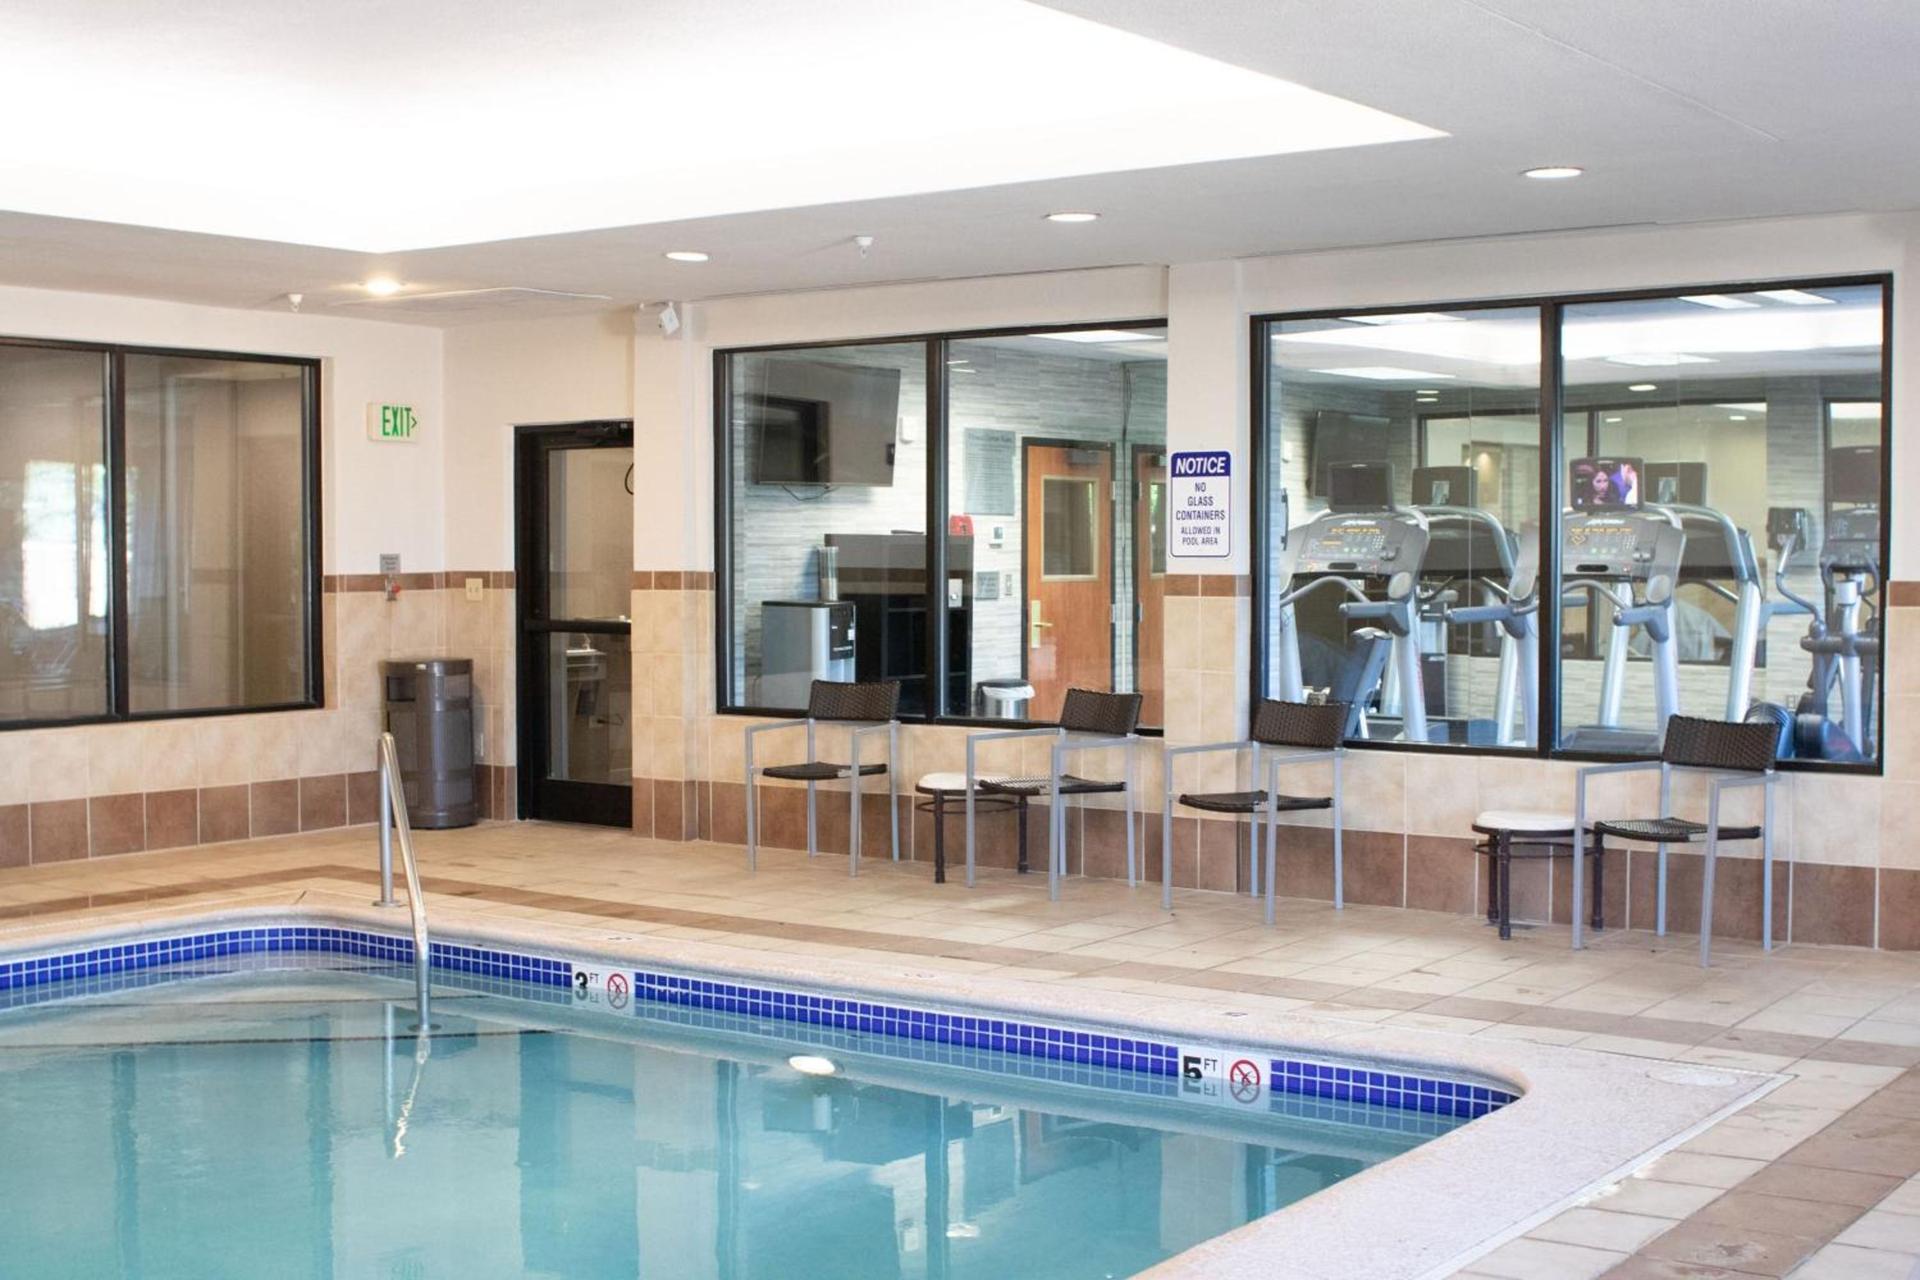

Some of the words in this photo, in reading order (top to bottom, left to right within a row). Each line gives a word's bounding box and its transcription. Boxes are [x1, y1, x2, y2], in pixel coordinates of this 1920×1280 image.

[382, 406, 411, 437] EXIT
[1175, 457, 1226, 474] NOTICE
[1195, 482, 1206, 492] NO
[1187, 496, 1214, 506] GLASS
[1176, 510, 1226, 520] CONTAINERS
[1181, 526, 1211, 534] ALLOWED
[1182, 537, 1199, 545] POOL
[1201, 537, 1218, 545] AREA
[575, 971, 588, 990] 3
[590, 973, 599, 983] FT
[1183, 1056, 1202, 1079] 5
[1204, 1058, 1218, 1072] FT
